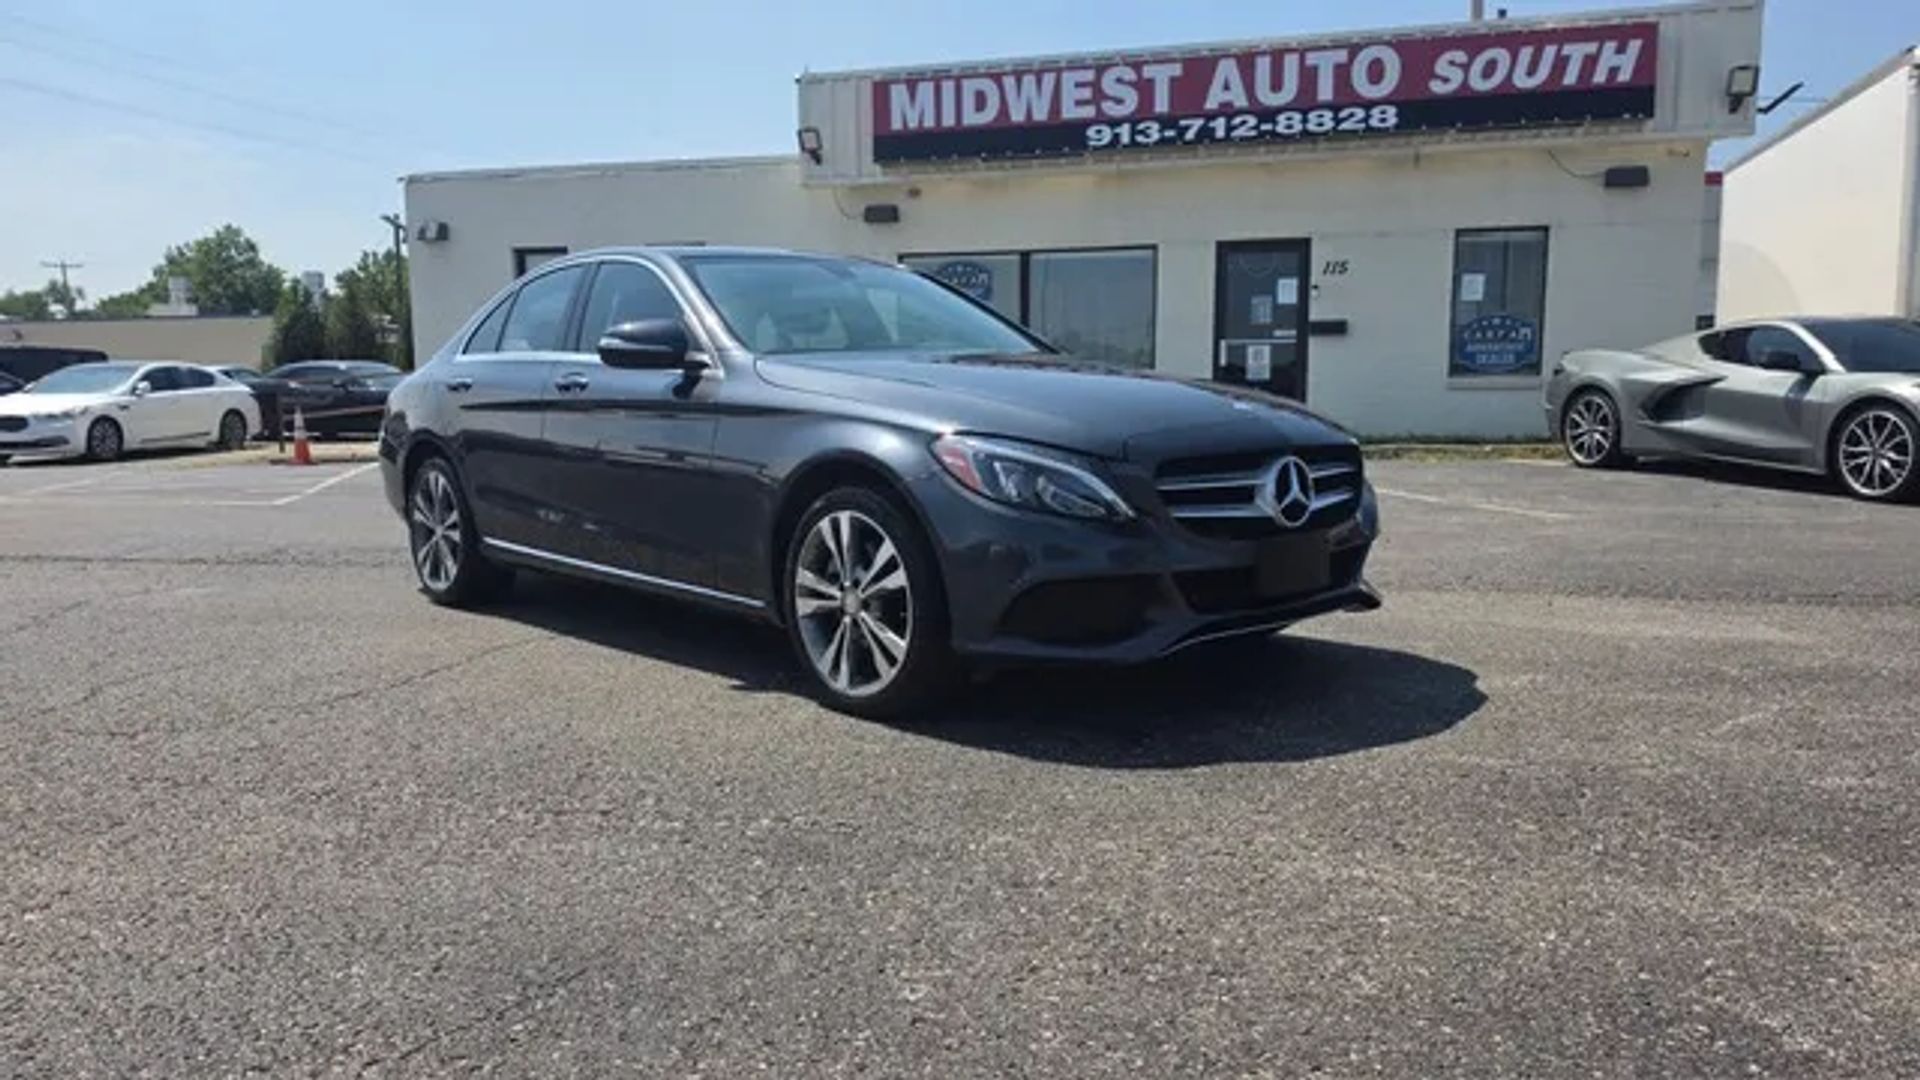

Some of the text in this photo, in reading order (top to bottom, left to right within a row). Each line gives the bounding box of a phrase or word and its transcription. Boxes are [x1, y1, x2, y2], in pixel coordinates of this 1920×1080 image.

[889, 39, 1643, 131] MIDWEST AUTO SOUTH
[1086, 104, 1399, 146] 913-712-8828
[1322, 259, 1349, 275] 115
